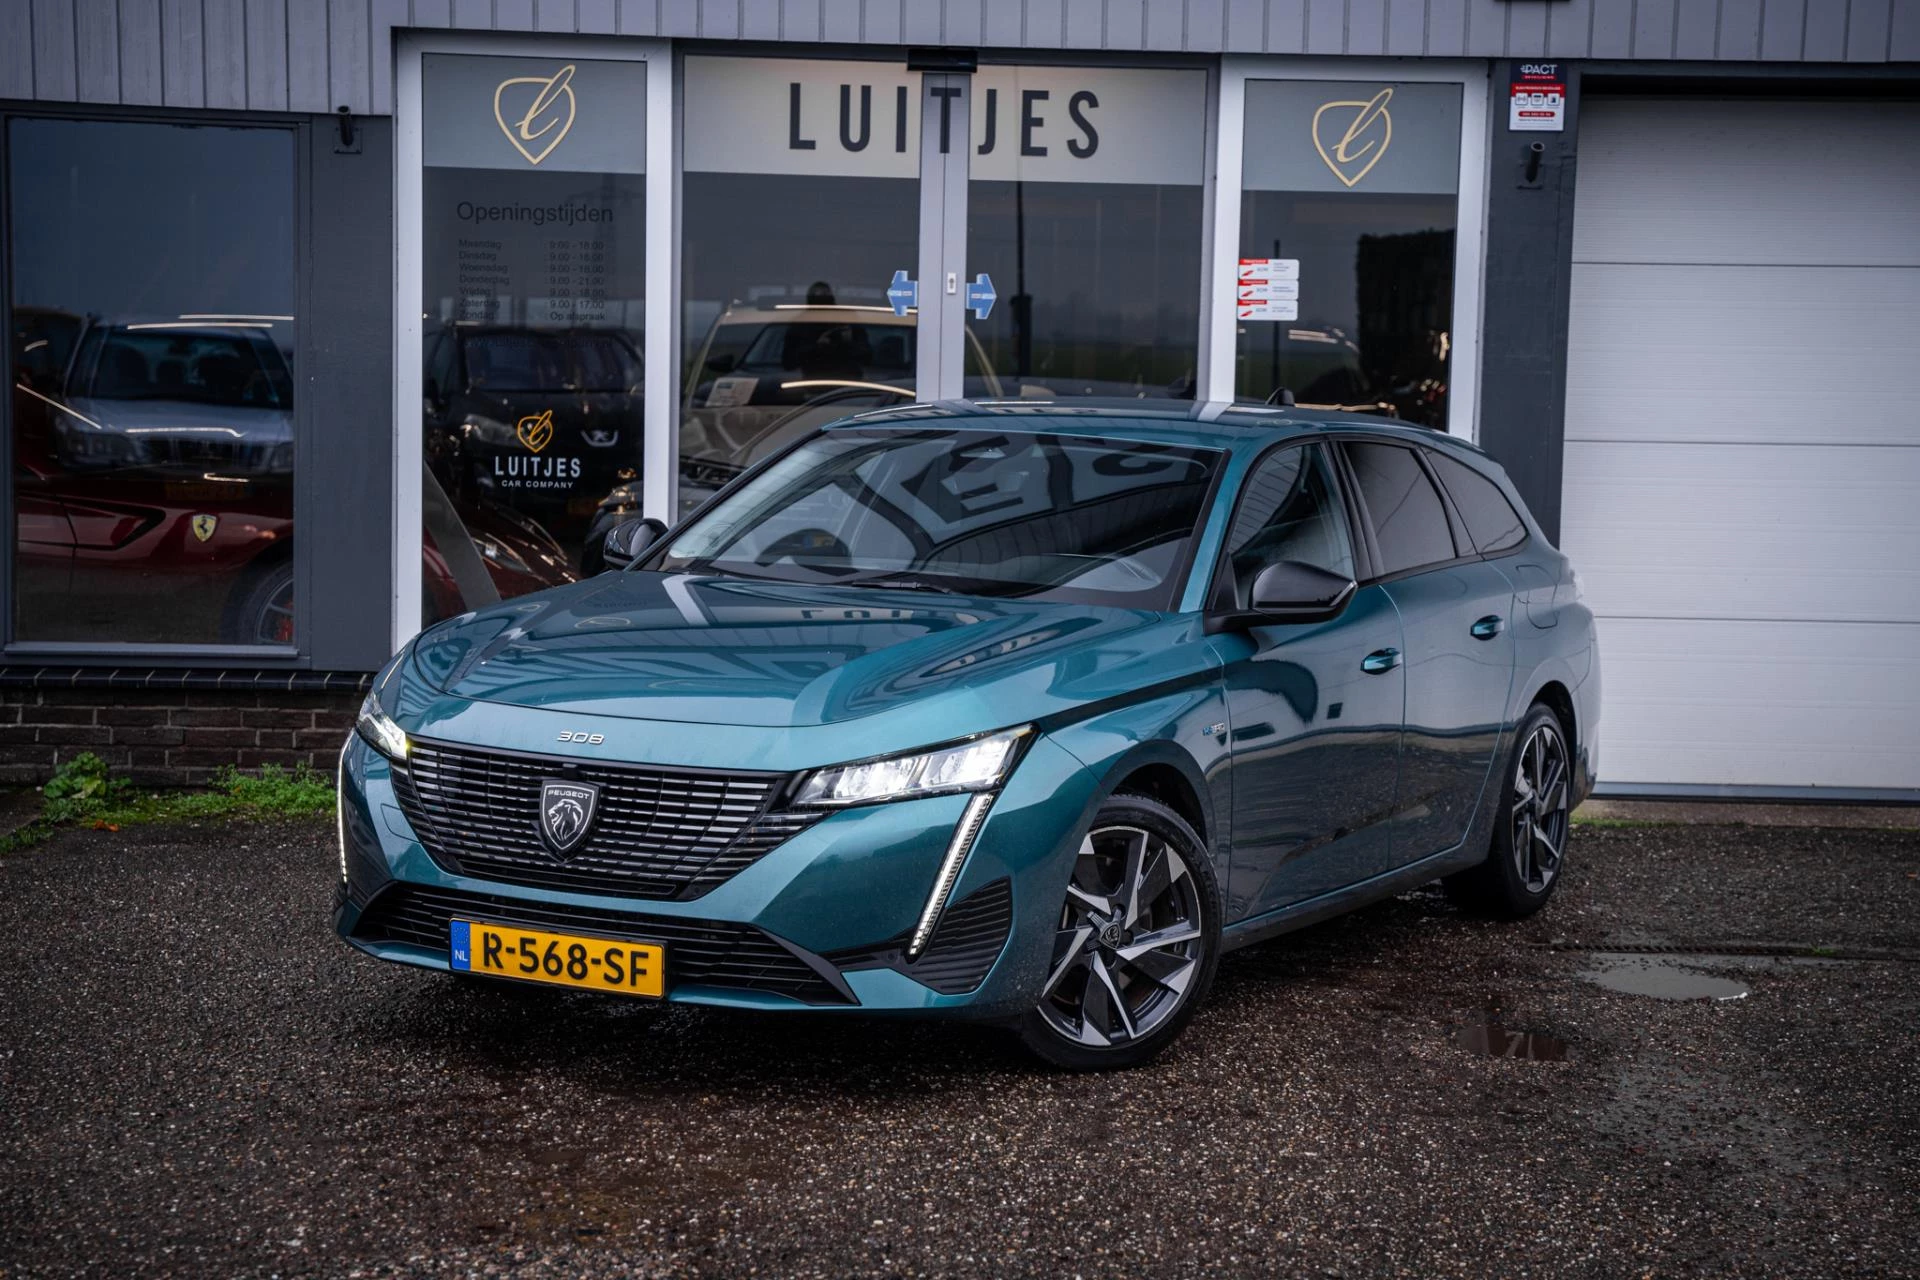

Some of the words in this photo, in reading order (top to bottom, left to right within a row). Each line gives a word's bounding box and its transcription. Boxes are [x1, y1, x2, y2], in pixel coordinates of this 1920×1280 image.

[789, 82, 1100, 160] LUITJES
[456, 201, 614, 226] Openingstijden
[458, 251, 497, 262] Dinsdag
[458, 263, 508, 274] Woensdag
[459, 274, 510, 286] Donderdag
[459, 287, 491, 298] Vrijdag
[550, 311, 564, 322] Op
[495, 456, 580, 478] LUITJES
[501, 480, 521, 488] CAR
[525, 480, 574, 489] COMPANY
[557, 730, 604, 745] 308
[547, 789, 590, 800] PEUGEOT
[454, 949, 469, 962] NL
[482, 931, 649, 987] R-568-SF
